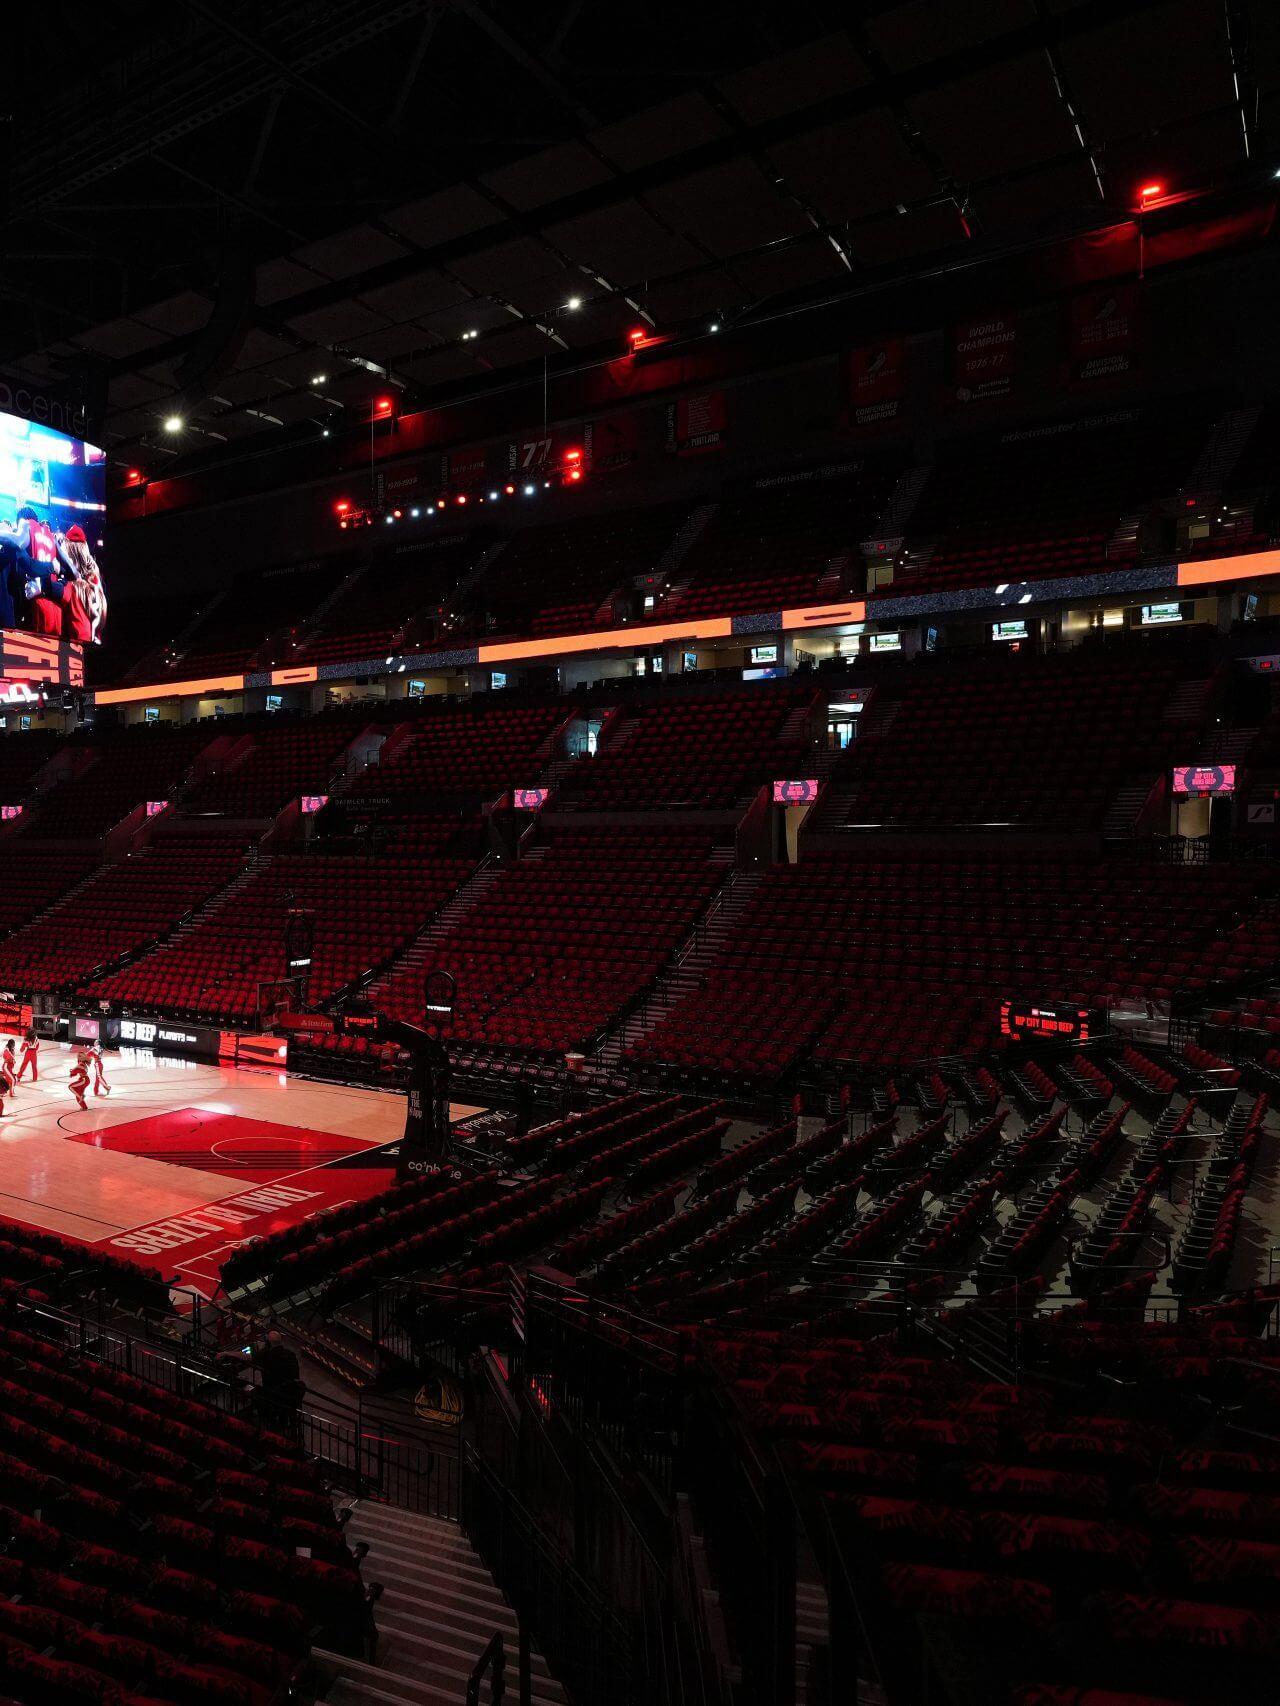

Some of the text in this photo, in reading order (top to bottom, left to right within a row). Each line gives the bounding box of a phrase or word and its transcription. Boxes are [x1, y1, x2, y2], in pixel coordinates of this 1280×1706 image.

[969, 322, 1004, 338] WORLD
[957, 331, 1015, 352] CHAMPIONS
[1088, 354, 1126, 367] DIVISION
[1081, 361, 1128, 378] CHAMPIONS
[522, 438, 552, 467] 77
[1015, 1016, 1026, 1026] RIP
[1027, 1018, 1040, 1027] CITY
[159, 1030, 186, 1042] PLAYOFFS
[110, 1184, 325, 1254] TRAIL BLAZERS
